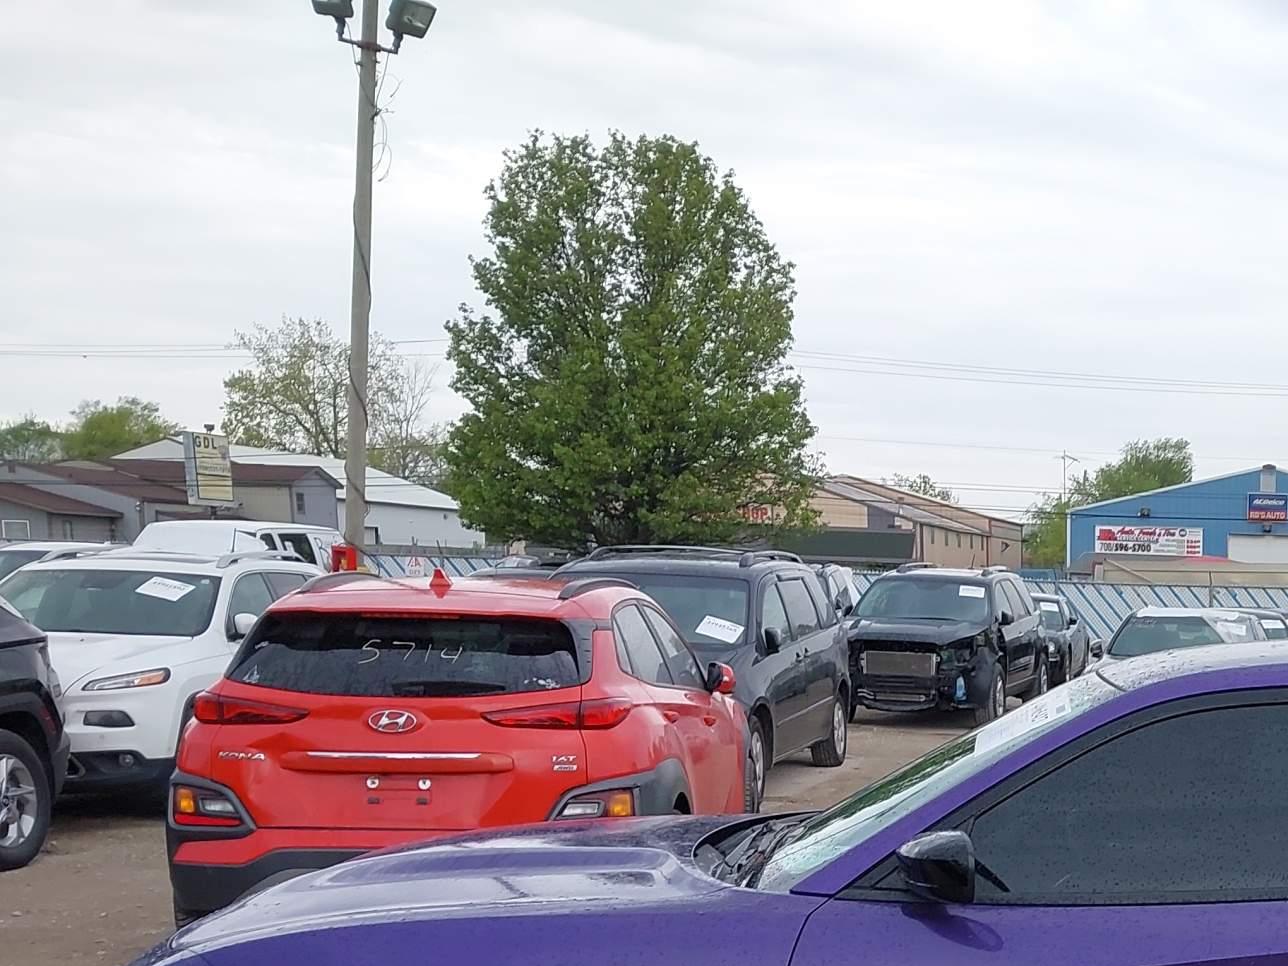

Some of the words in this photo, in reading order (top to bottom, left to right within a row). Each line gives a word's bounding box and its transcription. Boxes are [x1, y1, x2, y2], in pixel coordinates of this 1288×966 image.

[194, 435, 217, 449] GDL
[1266, 511, 1286, 520] AUTO
[358, 639, 464, 664] 5714
[218, 751, 265, 760] KONA
